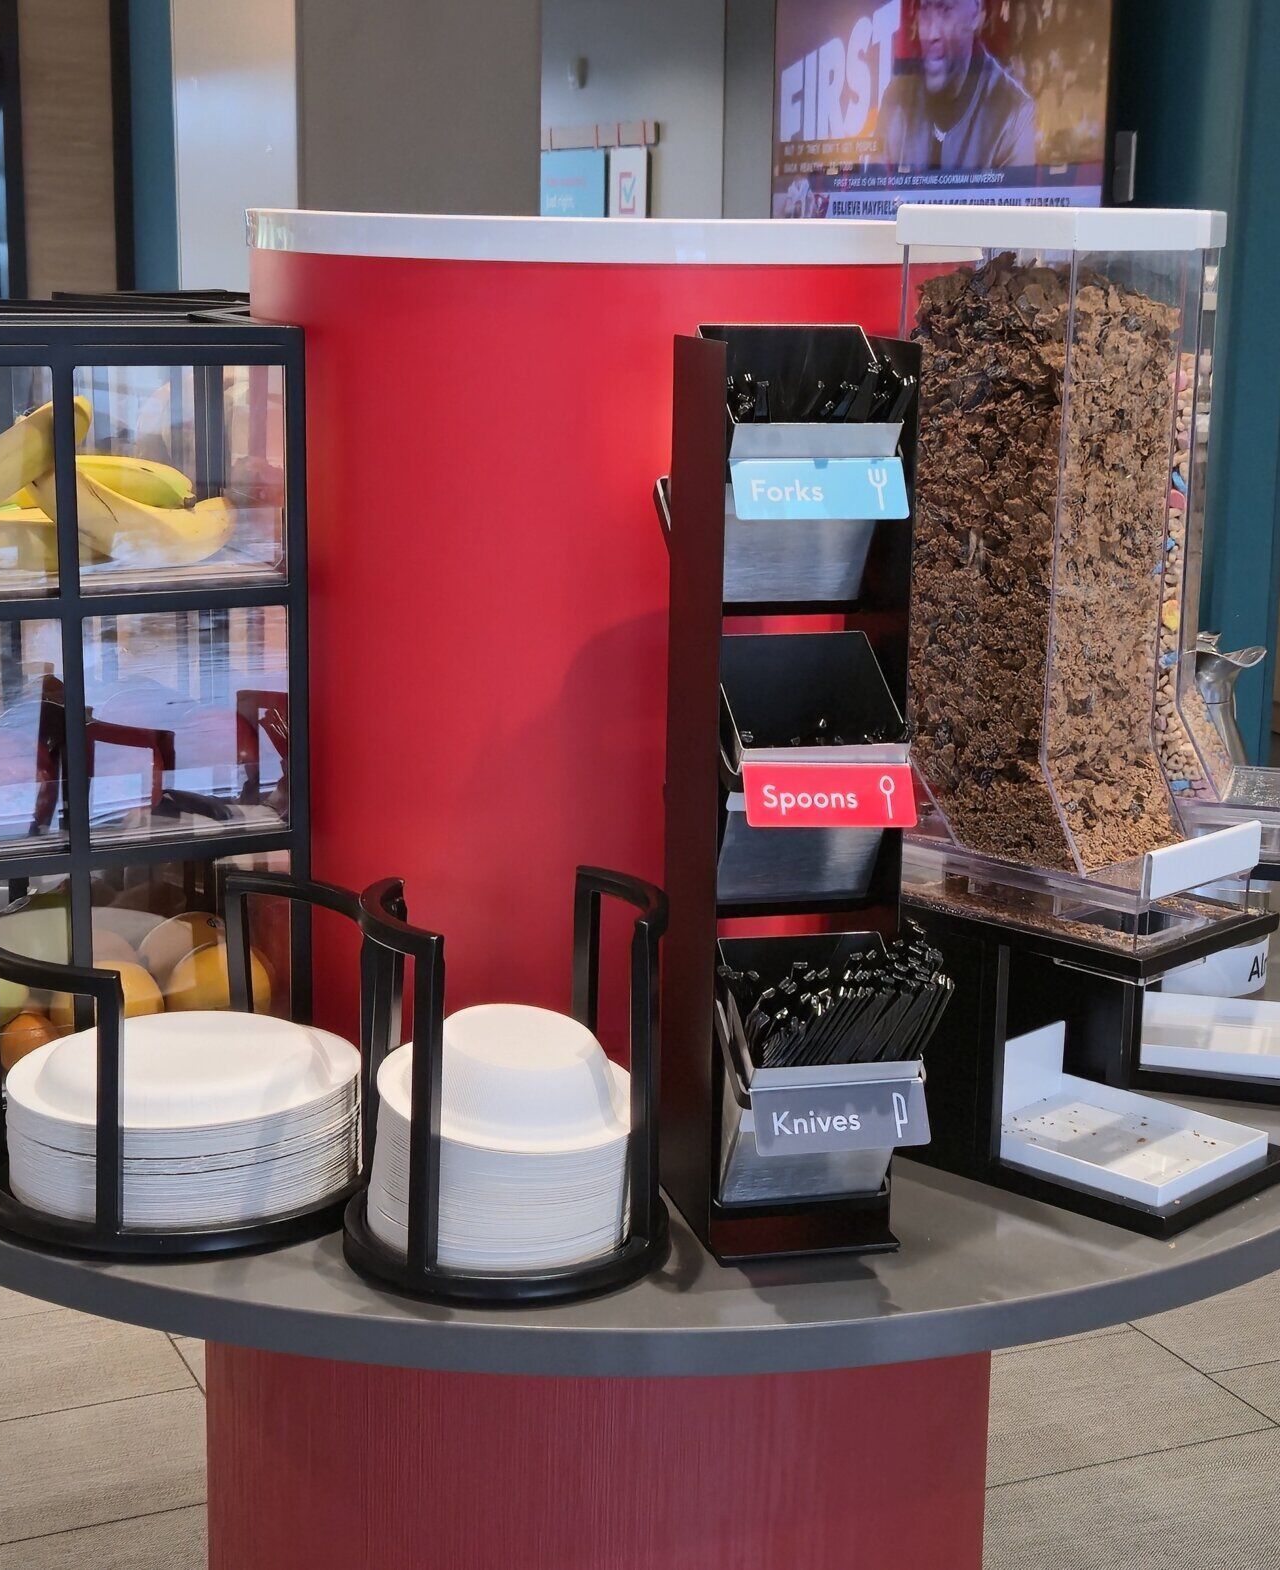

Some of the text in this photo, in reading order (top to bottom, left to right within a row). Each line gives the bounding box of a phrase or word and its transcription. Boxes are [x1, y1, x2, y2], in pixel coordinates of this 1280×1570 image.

[780, 0, 901, 142] FIRST
[833, 178, 848, 188] FIRST
[848, 178, 861, 188] TAKE
[861, 178, 867, 187] IS
[867, 178, 876, 187] ON
[877, 177, 887, 186] THE
[887, 177, 903, 186] ROAD
[904, 176, 912, 185] AT
[969, 172, 1005, 184] UNIVERSITY
[832, 201, 861, 216] BELIEVE
[751, 479, 825, 502] Forks
[762, 784, 859, 816] Spoons
[772, 1110, 861, 1136] Knives
